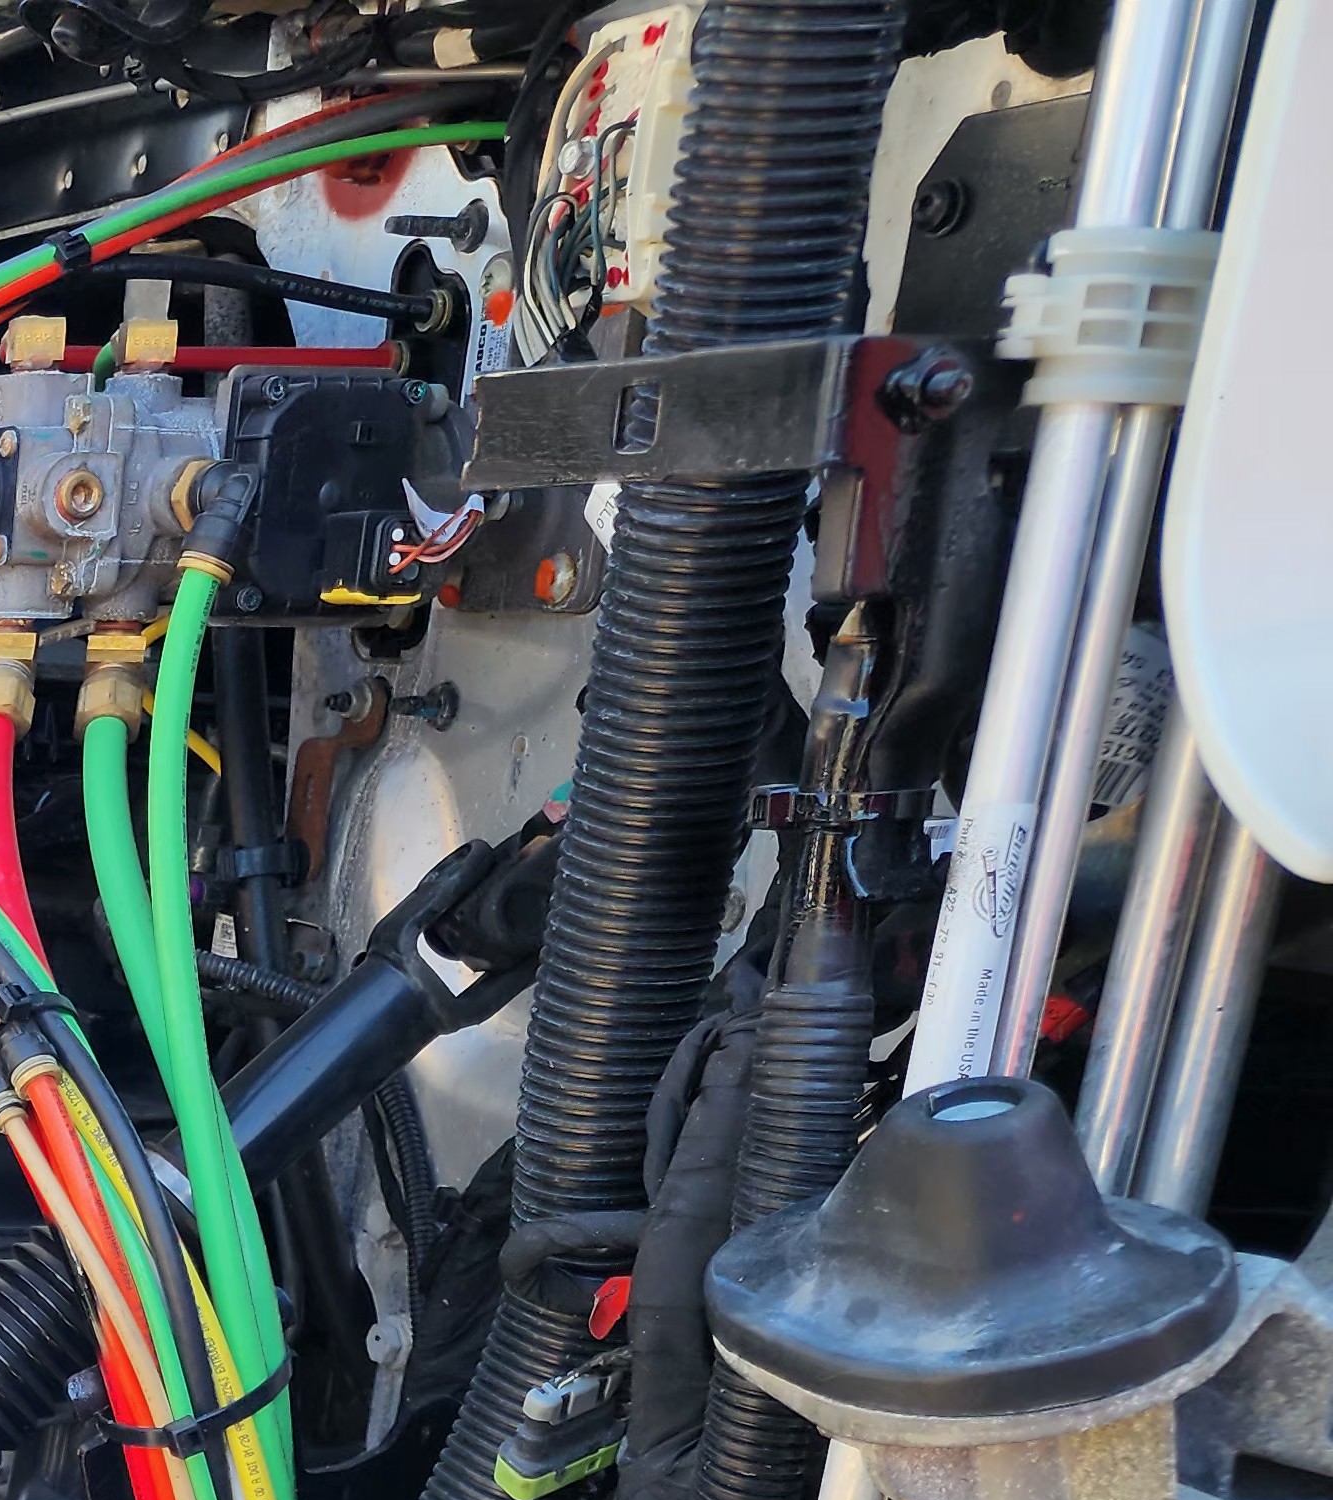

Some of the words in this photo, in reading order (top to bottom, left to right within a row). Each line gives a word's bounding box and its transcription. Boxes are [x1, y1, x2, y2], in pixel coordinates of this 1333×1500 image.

[473, 323, 488, 371] ABCO
[957, 817, 972, 844] Part
[974, 969, 992, 1004] Made
[969, 1011, 983, 1021] in
[964, 1029, 980, 1048] the
